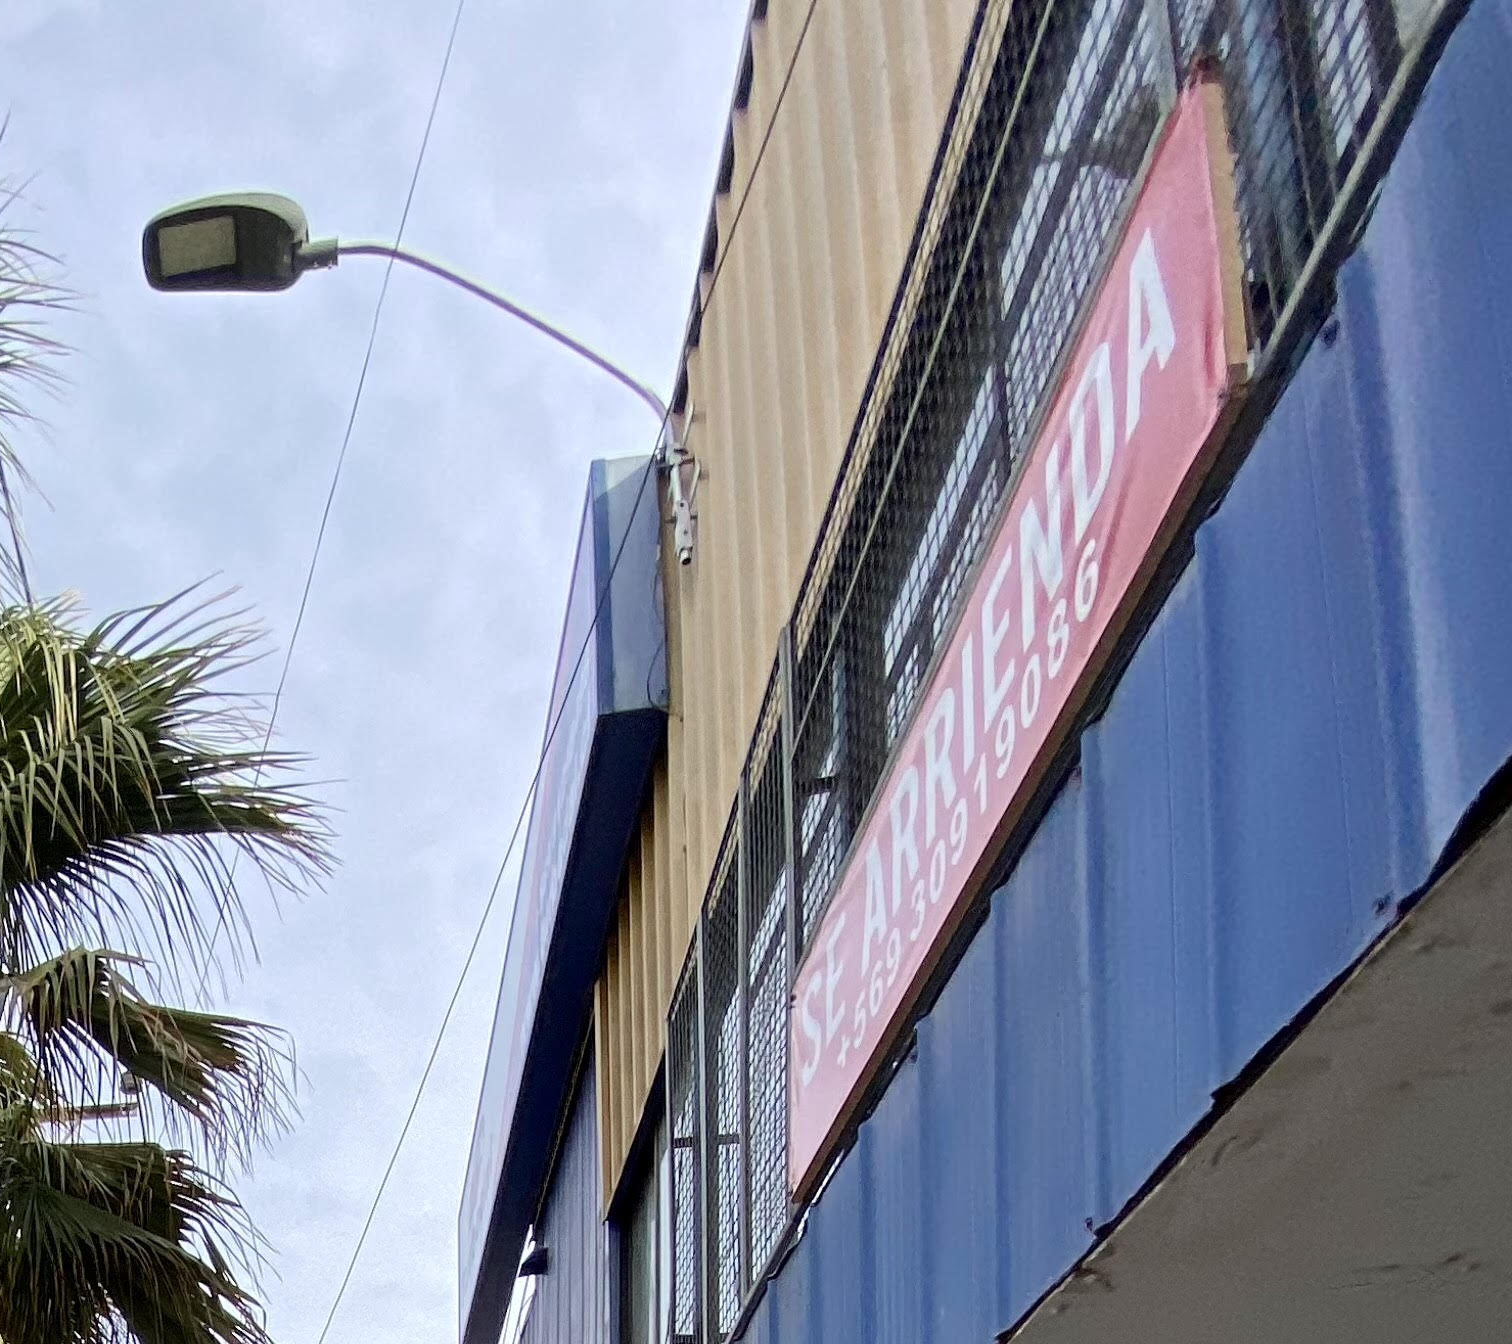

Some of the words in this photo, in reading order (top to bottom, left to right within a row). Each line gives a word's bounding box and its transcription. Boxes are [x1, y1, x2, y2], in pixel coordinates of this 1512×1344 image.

[799, 911, 846, 1087] SE
[861, 227, 1176, 975] ARRIENDA
[836, 927, 902, 1068] +569
[910, 538, 1099, 944] 30919086
